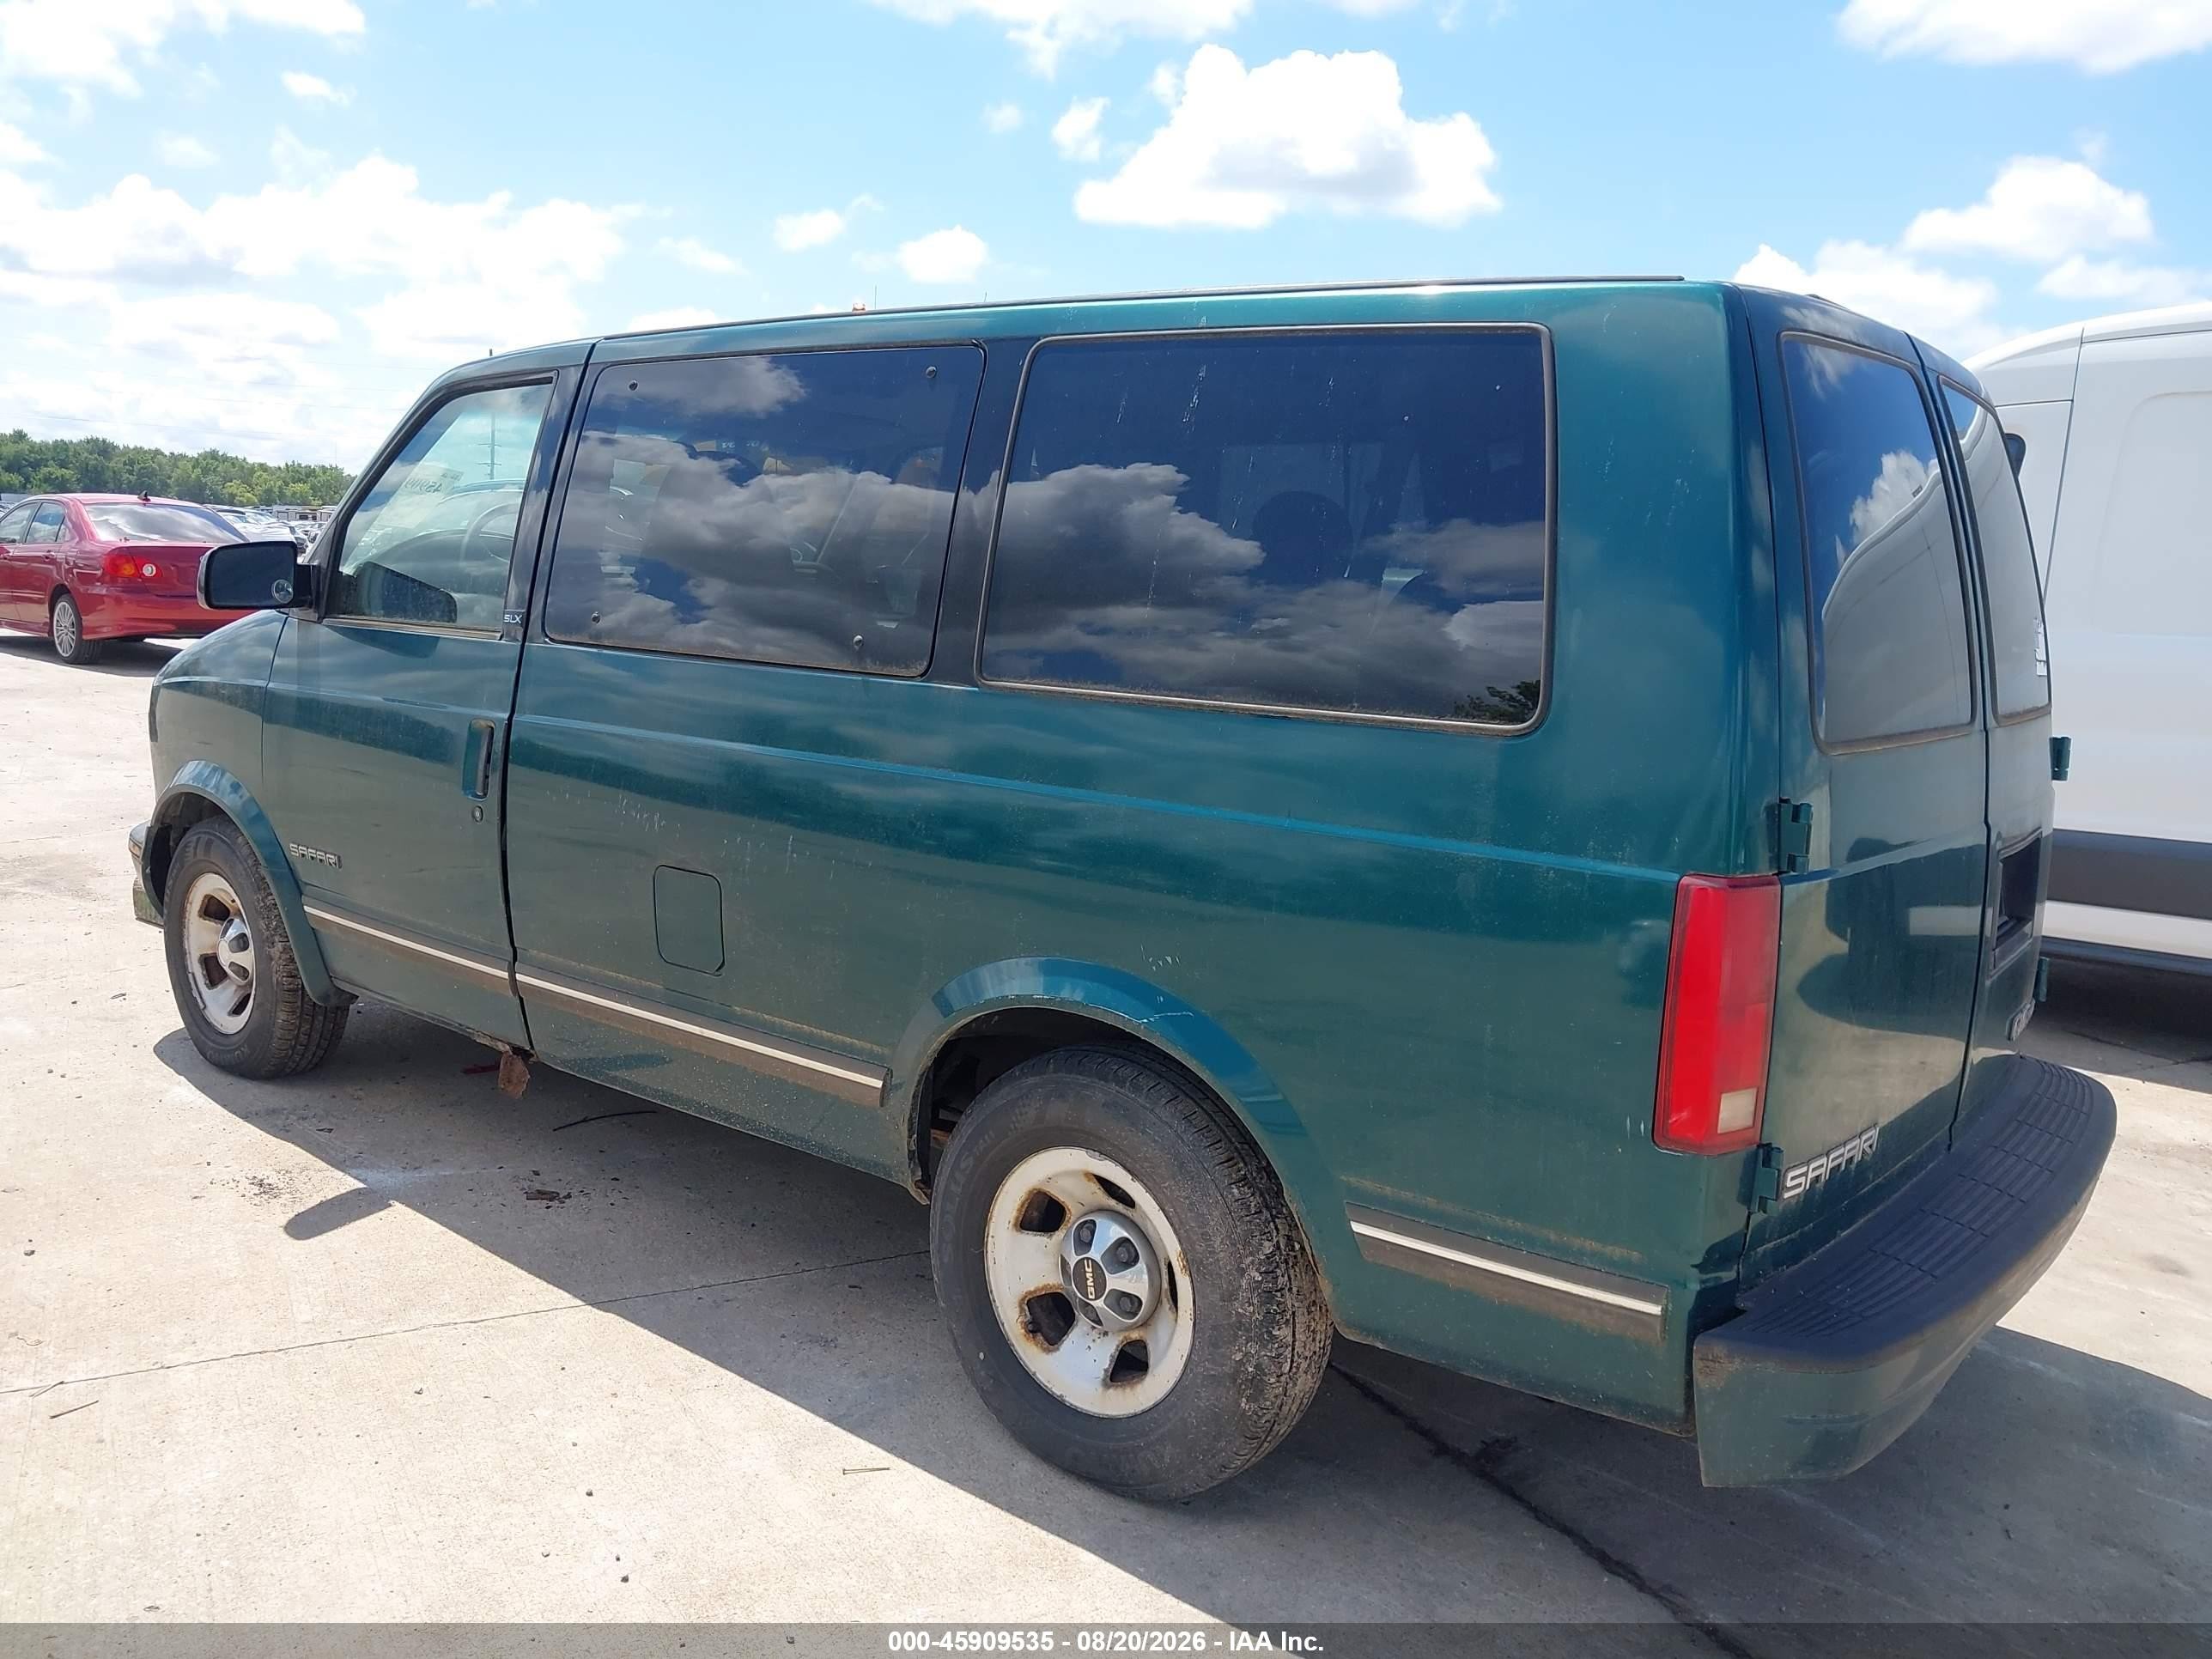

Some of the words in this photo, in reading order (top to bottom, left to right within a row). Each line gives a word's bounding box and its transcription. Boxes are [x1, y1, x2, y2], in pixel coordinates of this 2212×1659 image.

[503, 614, 523, 624] SLX
[289, 842, 340, 869] SAFARI
[1783, 1126, 1881, 1200] SAFARI
[1084, 1258, 1096, 1299] GMC
